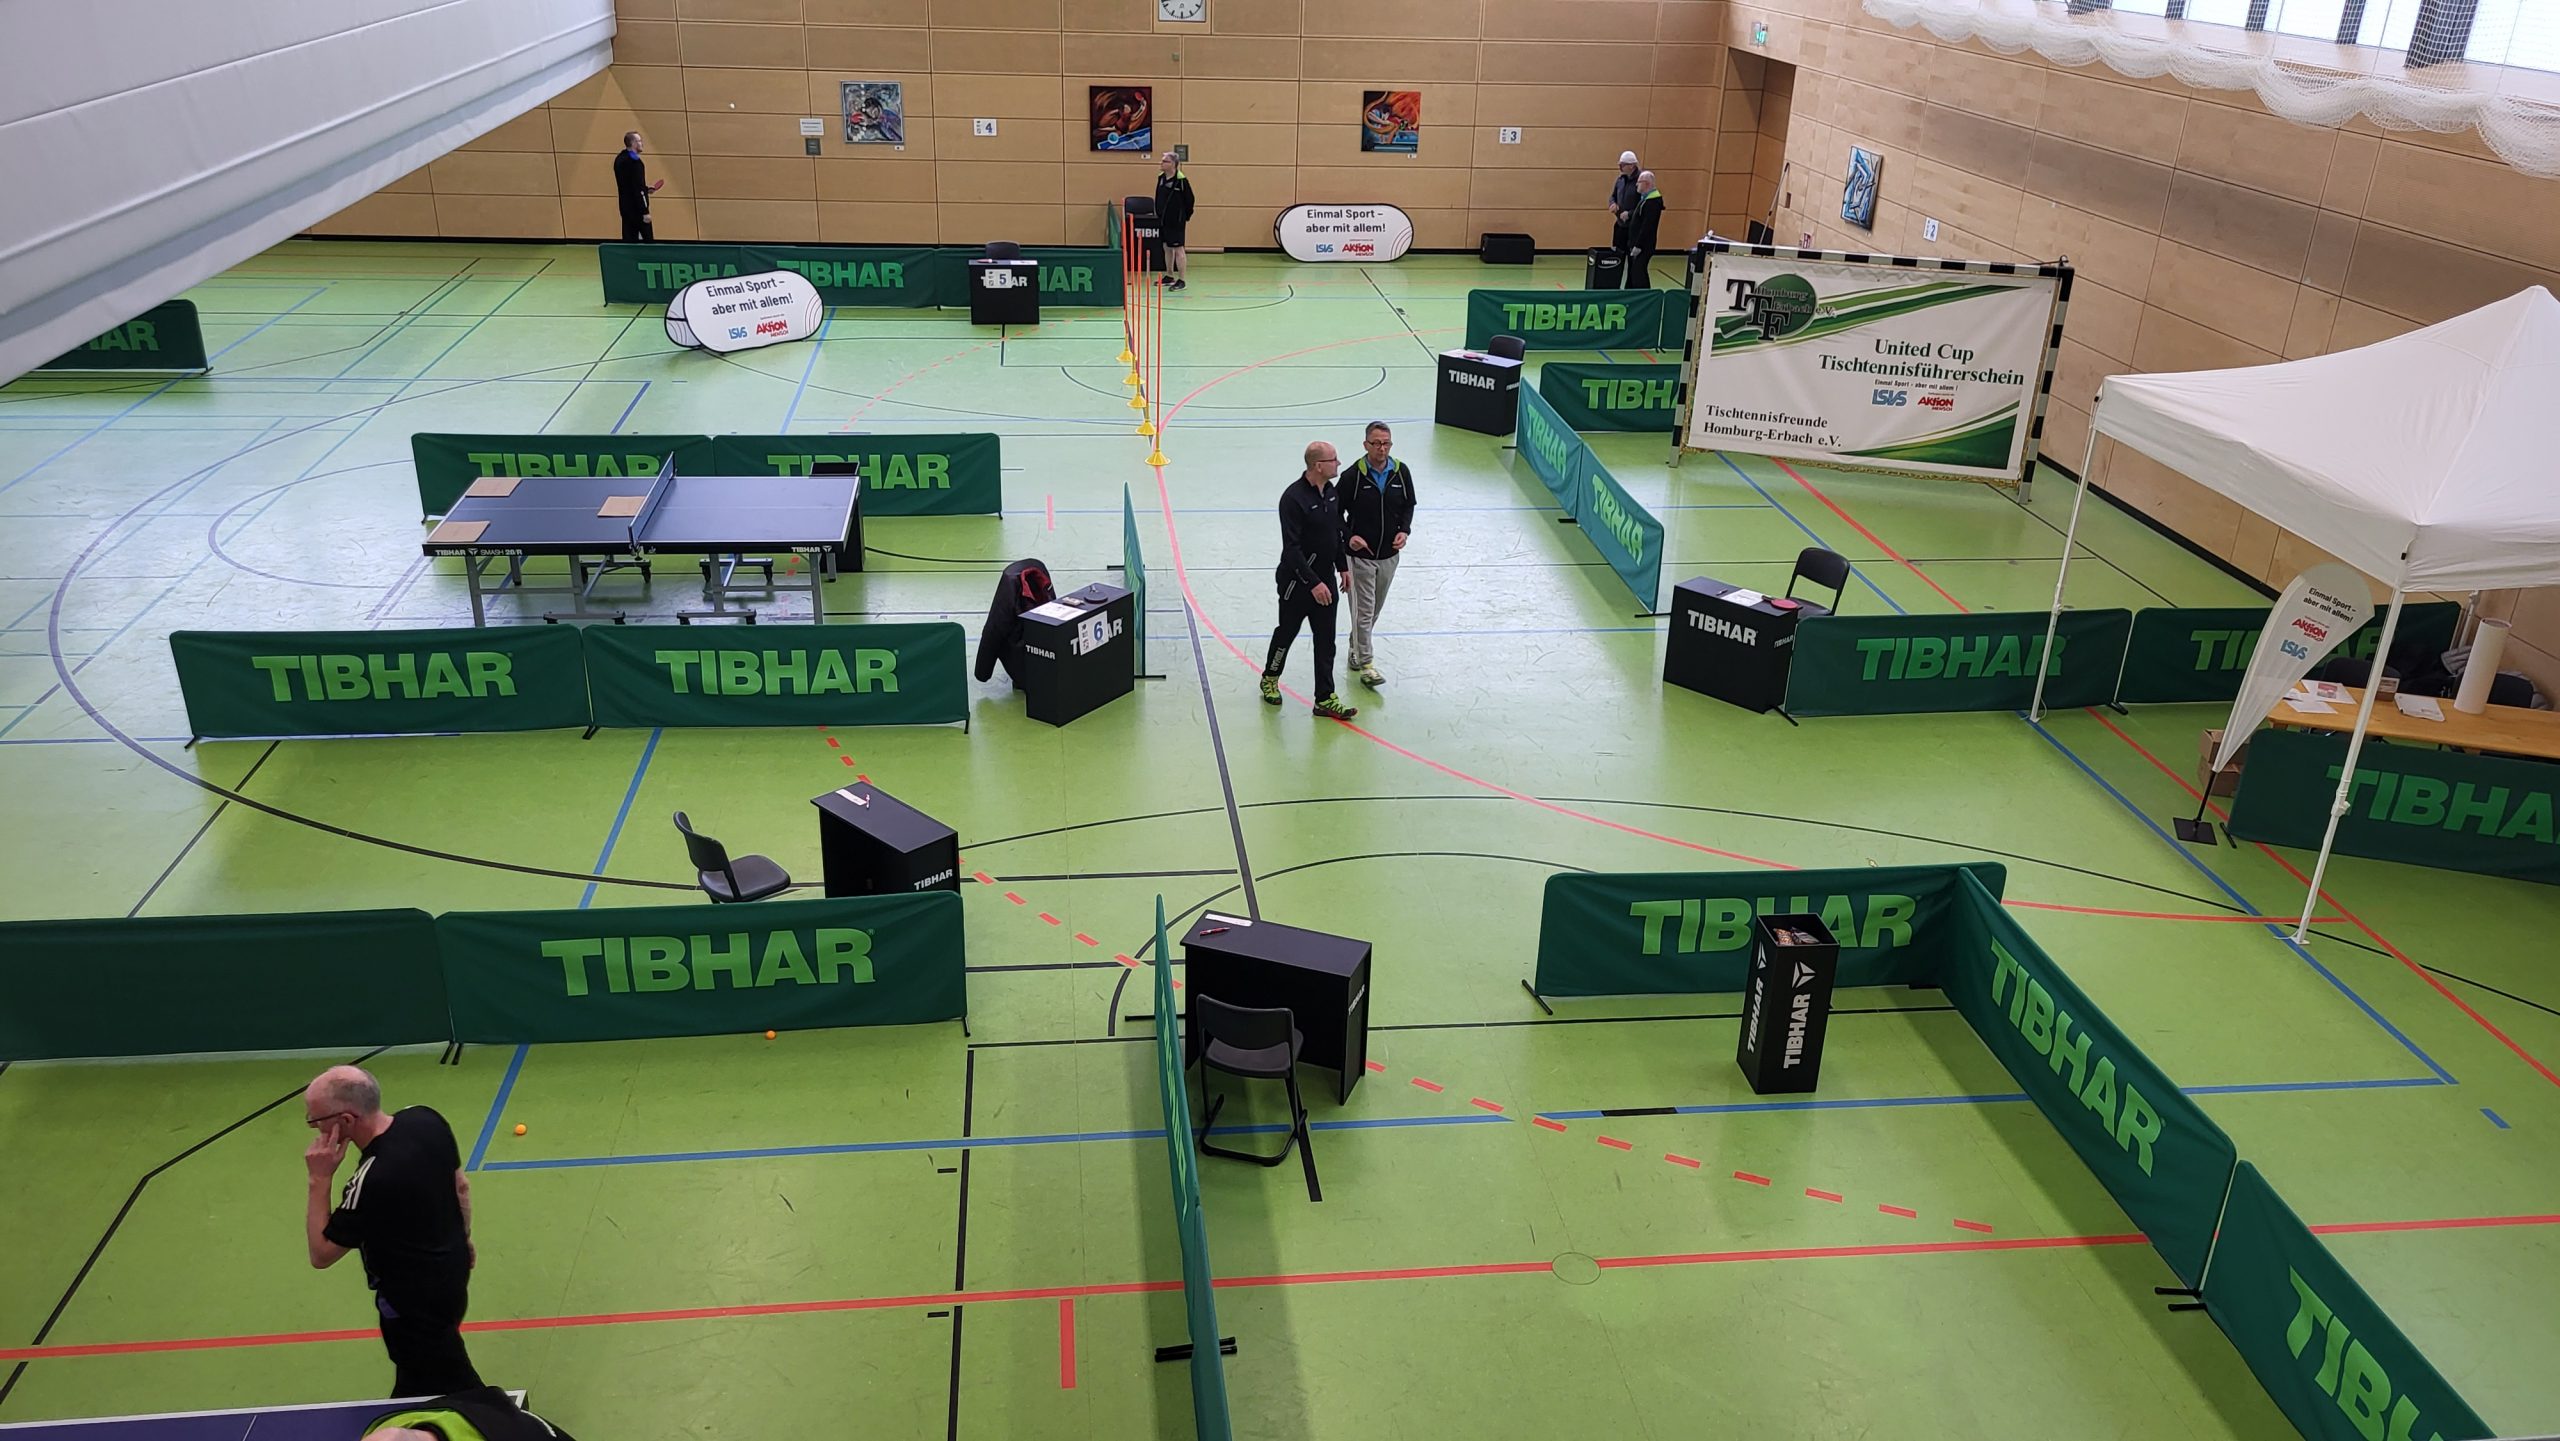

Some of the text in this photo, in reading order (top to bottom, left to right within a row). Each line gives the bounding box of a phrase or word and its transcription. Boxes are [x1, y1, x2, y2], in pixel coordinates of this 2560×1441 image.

[985, 122, 992, 133] 4
[1510, 131, 1517, 141] 3
[1307, 209, 1343, 219] Einmal
[1345, 210, 1375, 220] Sport
[1134, 228, 1160, 238] TIBH
[1306, 223, 1386, 233] aber mit allem!
[706, 282, 745, 298] Einmal
[745, 278, 778, 293] Sport
[1000, 273, 1007, 285] 5
[712, 293, 794, 316] aber mit allem!
[1502, 303, 1628, 331] TIBHAR
[1874, 338, 1974, 366] United Cup
[1448, 369, 1496, 391] TIBHAR
[1818, 354, 2025, 386] Tischtennisführerschein
[1581, 379, 1679, 410] TIBH
[1894, 380, 1910, 388] Sport
[1705, 404, 1828, 428] Tischtennisfreunde
[1703, 422, 1842, 448] Homburg-Erbach e.V.
[2303, 597, 2319, 608] aber
[2319, 603, 2332, 613] mit
[2331, 609, 2354, 623] allem!
[2308, 587, 2333, 602] Einmal
[2332, 597, 2352, 612] Sport
[1093, 621, 1104, 641] 6
[1687, 609, 1758, 647] TIBHAR
[1025, 644, 1056, 660] TIBHAR
[252, 651, 518, 702] TIBHAR
[655, 648, 900, 696] TIBHAR
[2325, 765, 2560, 844] TIBHA
[914, 868, 953, 890] TIBHAR
[541, 928, 876, 996] TIBHAR
[1747, 976, 1764, 1053] TIBHAR
[1783, 993, 1811, 1069] TIBHAR
[1991, 936, 2164, 1178] TIBHAR
